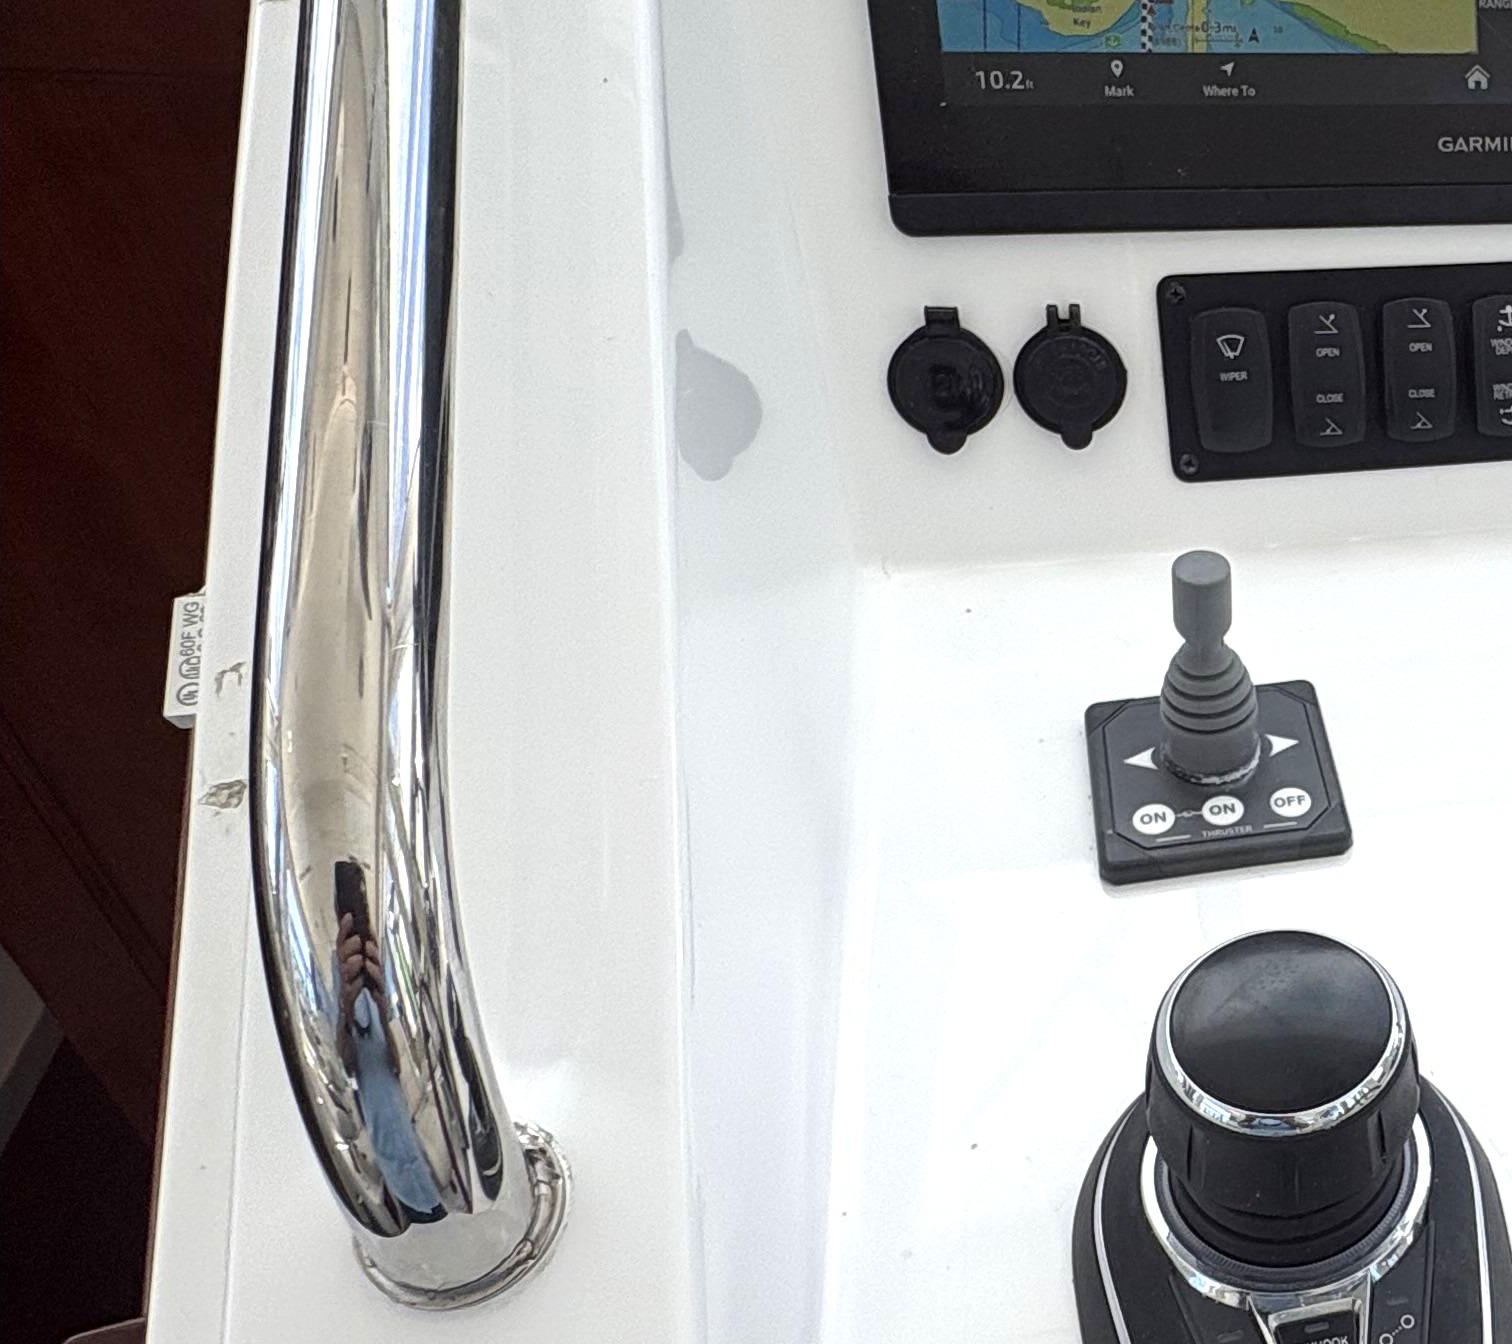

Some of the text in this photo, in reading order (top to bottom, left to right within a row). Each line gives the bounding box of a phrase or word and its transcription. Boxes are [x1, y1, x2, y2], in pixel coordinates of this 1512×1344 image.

[1104, 85, 1135, 97] Mark
[1202, 85, 1257, 98] Where To
[1316, 346, 1341, 358] OPEN
[1409, 341, 1433, 353] OPEN
[1219, 370, 1248, 382] WIPER
[1316, 392, 1344, 404] CLOSE
[1408, 387, 1435, 399] CLOSE
[1273, 794, 1306, 810] OFF
[1208, 802, 1237, 817] ON
[1139, 811, 1168, 826] ON
[1202, 825, 1253, 839] THRUSTER
